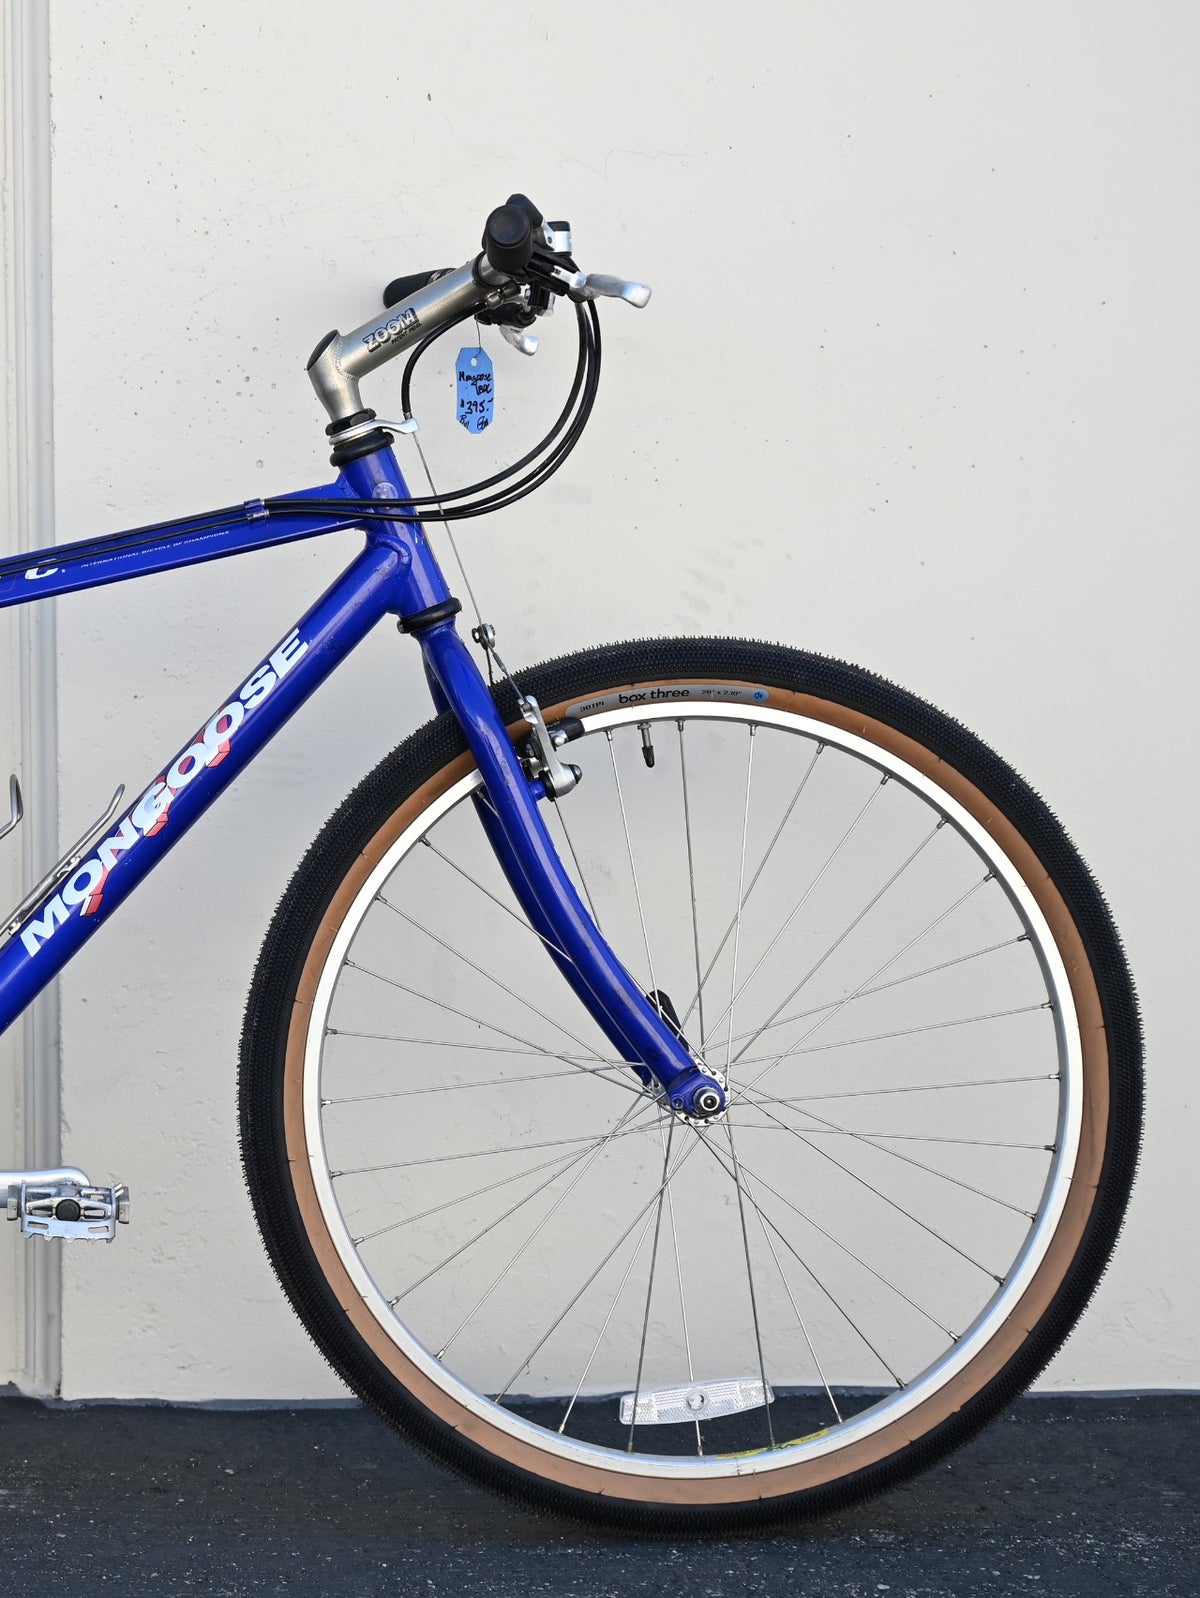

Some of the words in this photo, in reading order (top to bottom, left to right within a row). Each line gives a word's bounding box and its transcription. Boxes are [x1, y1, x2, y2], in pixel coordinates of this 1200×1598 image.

[362, 307, 420, 353] ZOOM
[80, 552, 139, 568] INTERNATIONAL
[141, 544, 171, 556] BICYCLE
[183, 530, 230, 545] CHAMPIONS
[618, 693, 647, 704] box
[649, 688, 690, 699] three
[19, 627, 309, 957] MONGOOSE
